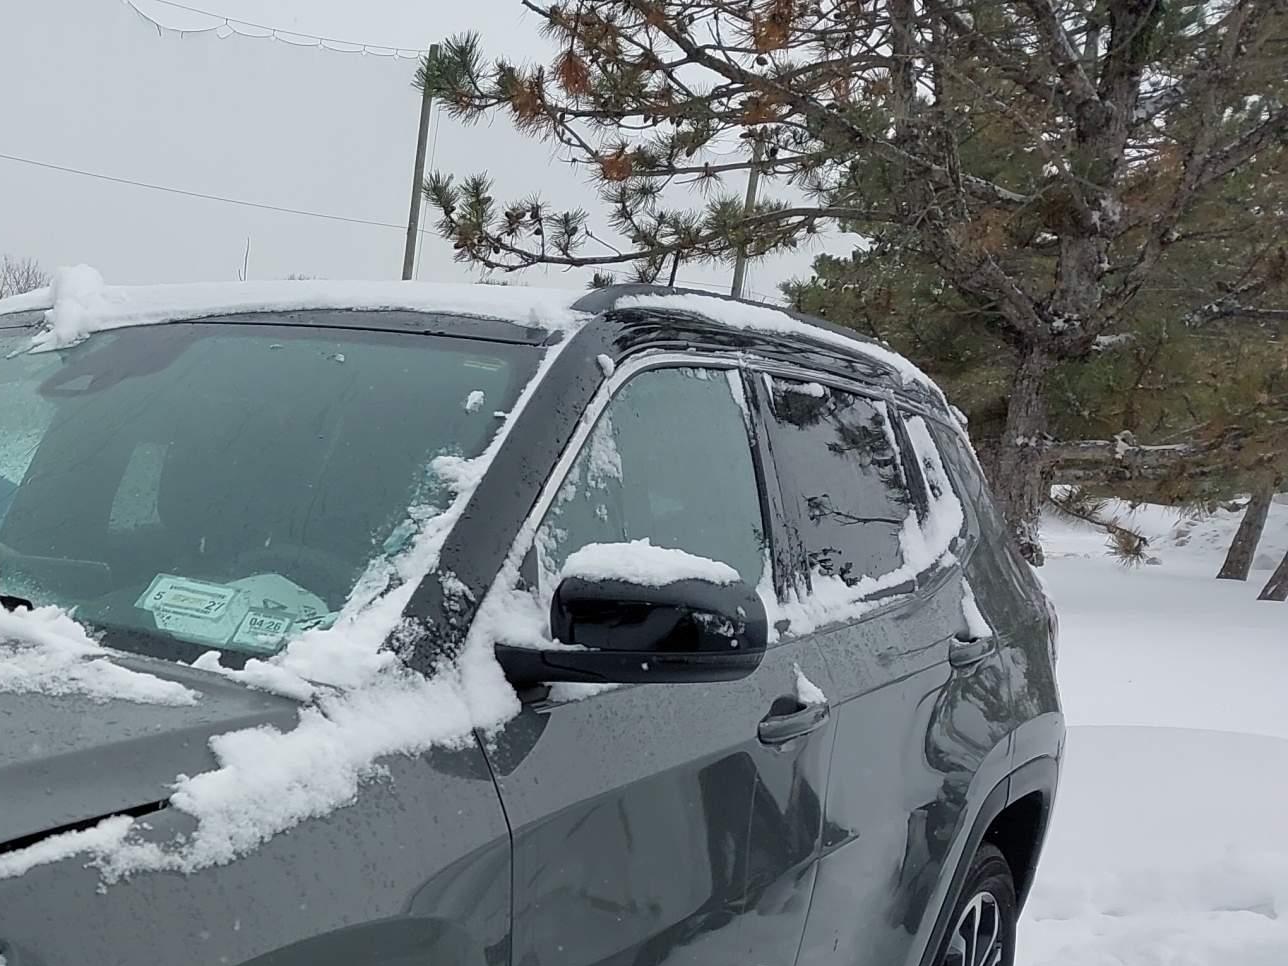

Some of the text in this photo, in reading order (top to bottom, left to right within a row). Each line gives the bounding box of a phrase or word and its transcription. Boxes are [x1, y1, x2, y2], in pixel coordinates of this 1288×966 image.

[153, 591, 166, 601] 5
[249, 616, 265, 628] 04
[265, 620, 283, 632] 26
